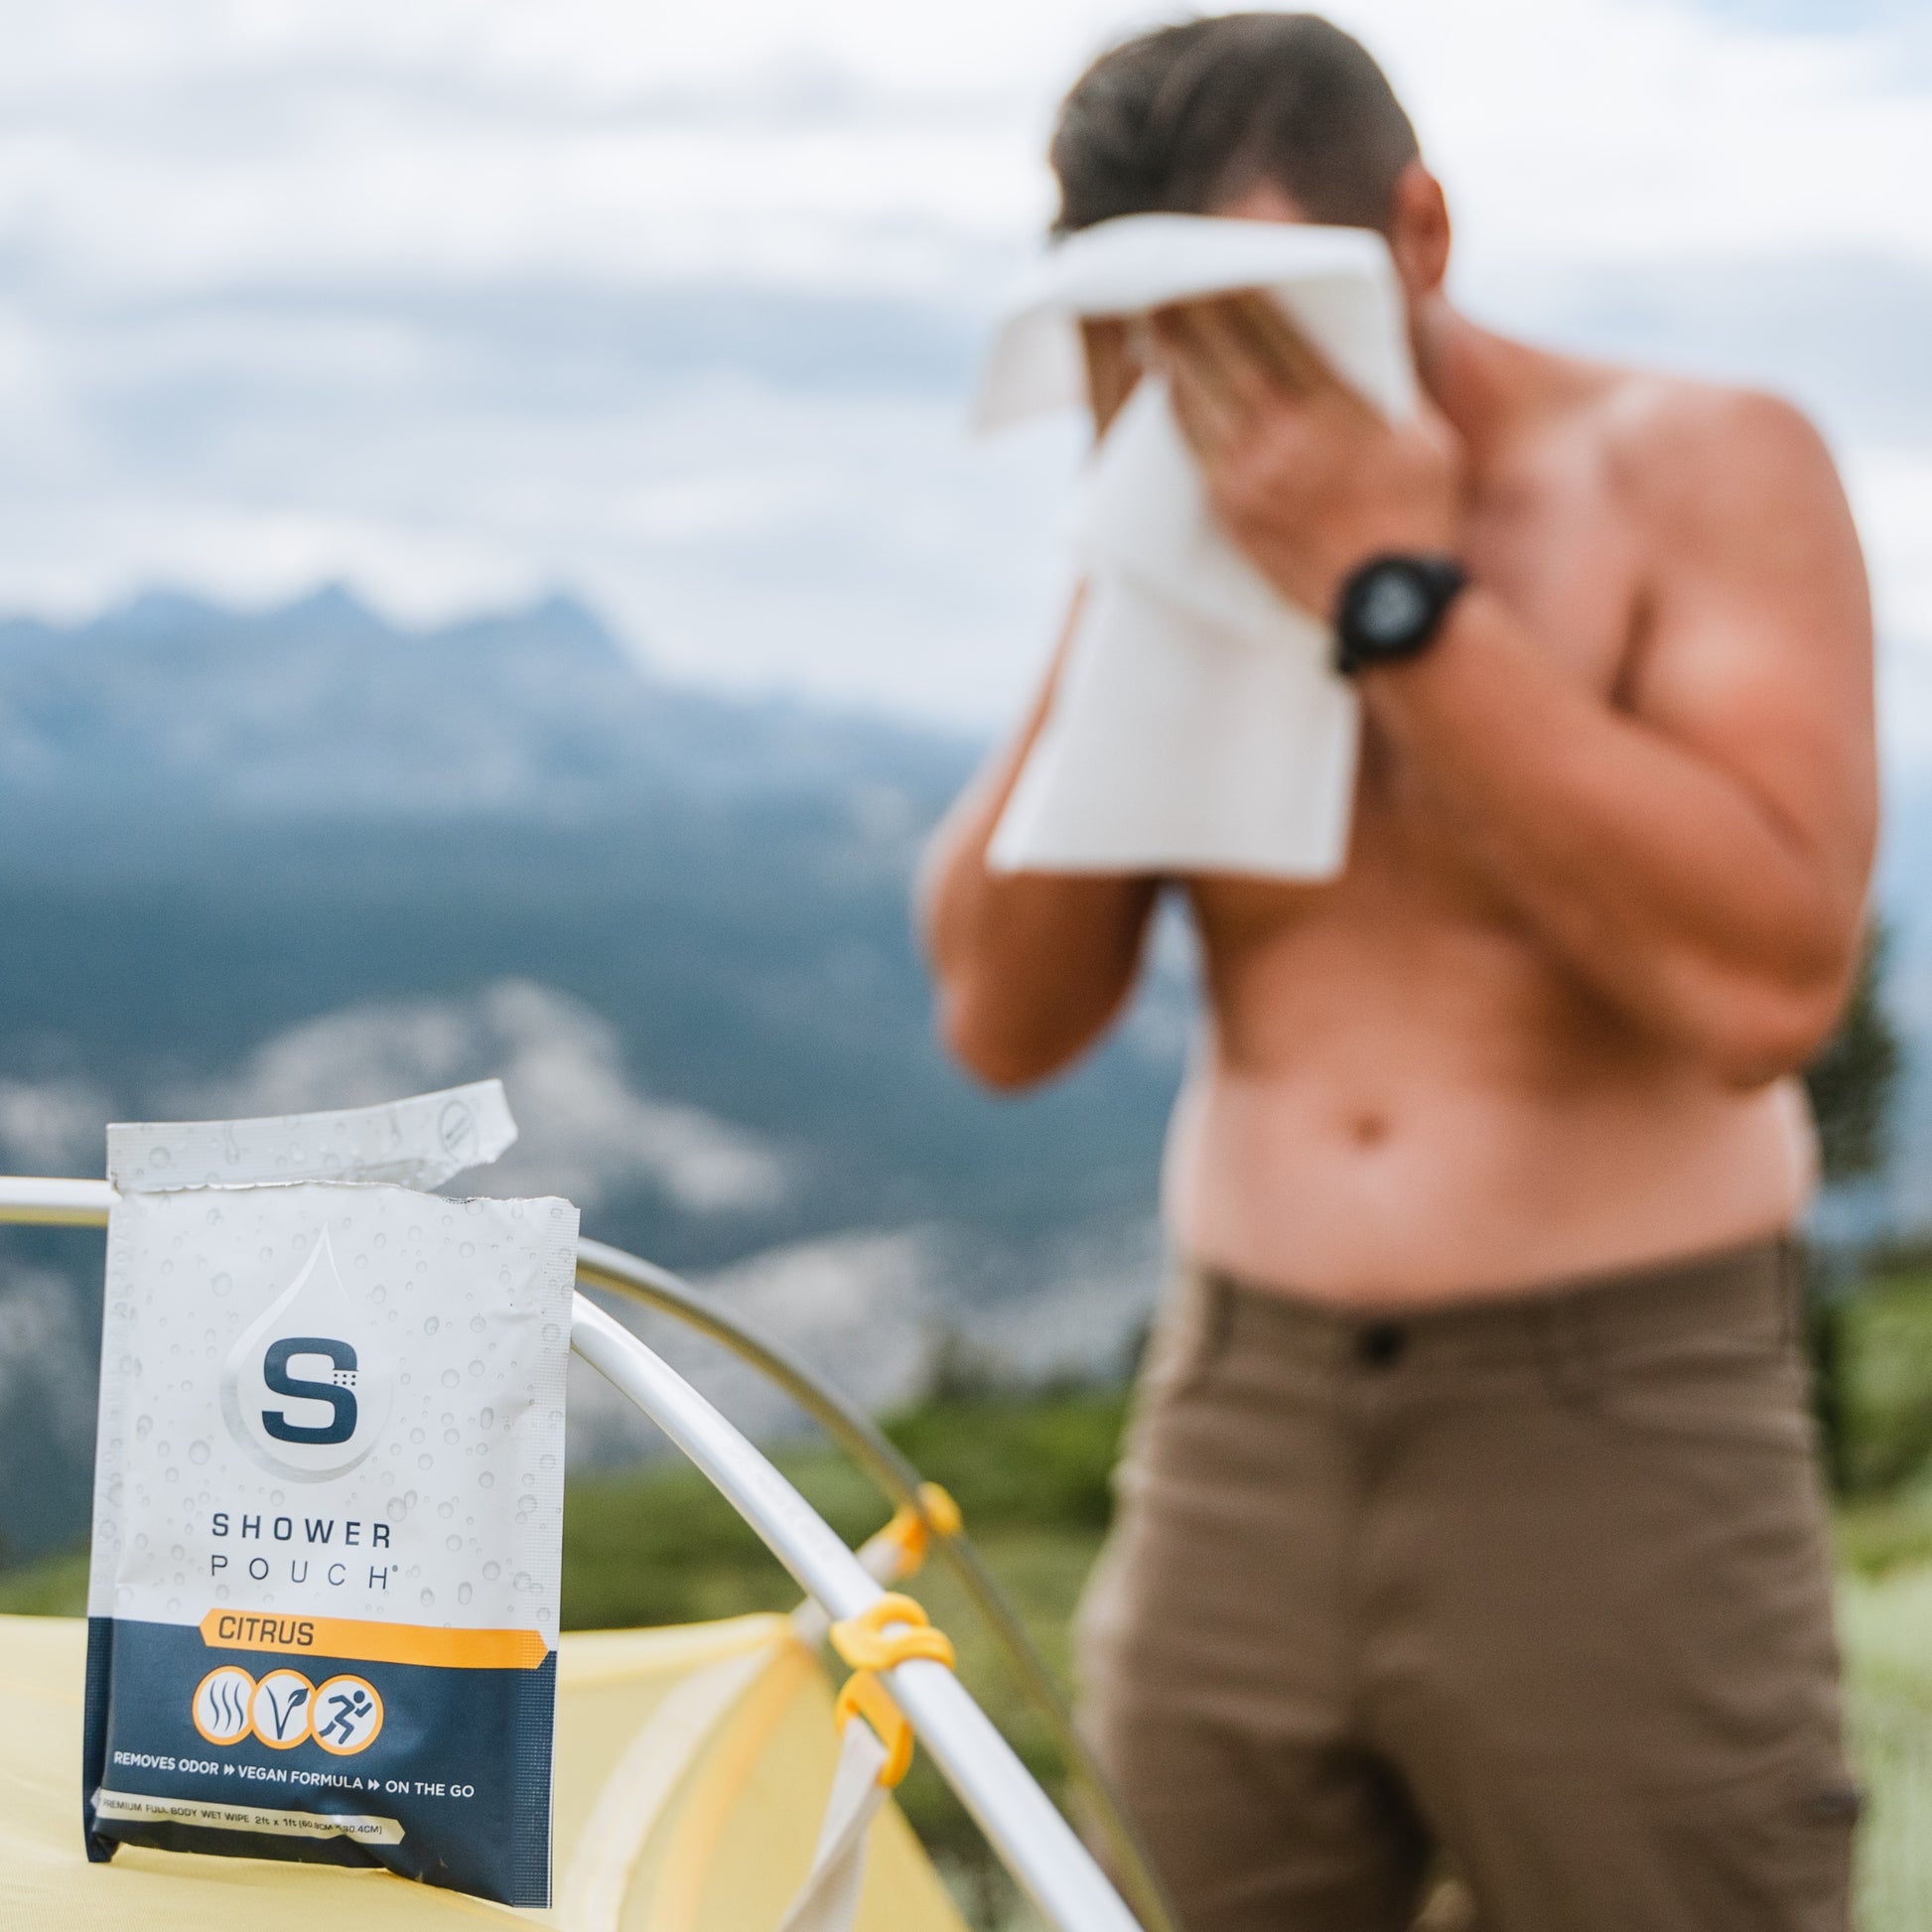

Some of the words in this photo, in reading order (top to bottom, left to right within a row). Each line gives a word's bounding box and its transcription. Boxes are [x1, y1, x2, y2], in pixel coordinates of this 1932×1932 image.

[261, 1337, 358, 1445] S
[211, 1513, 390, 1549] SHOWER
[218, 1615, 315, 1646] CITRUS
[113, 1750, 176, 1770] REMOVES
[178, 1758, 219, 1775] ODOR
[237, 1765, 287, 1783] VEGAN
[290, 1770, 363, 1790] FORMULA
[385, 1780, 410, 1794] ON
[414, 1782, 446, 1796] THE
[450, 1785, 475, 1798] GO
[102, 1798, 143, 1812] PREMIUM
[170, 1807, 198, 1817] BODY
[201, 1810, 222, 1820] WET
[224, 1812, 250, 1824] WIPE
